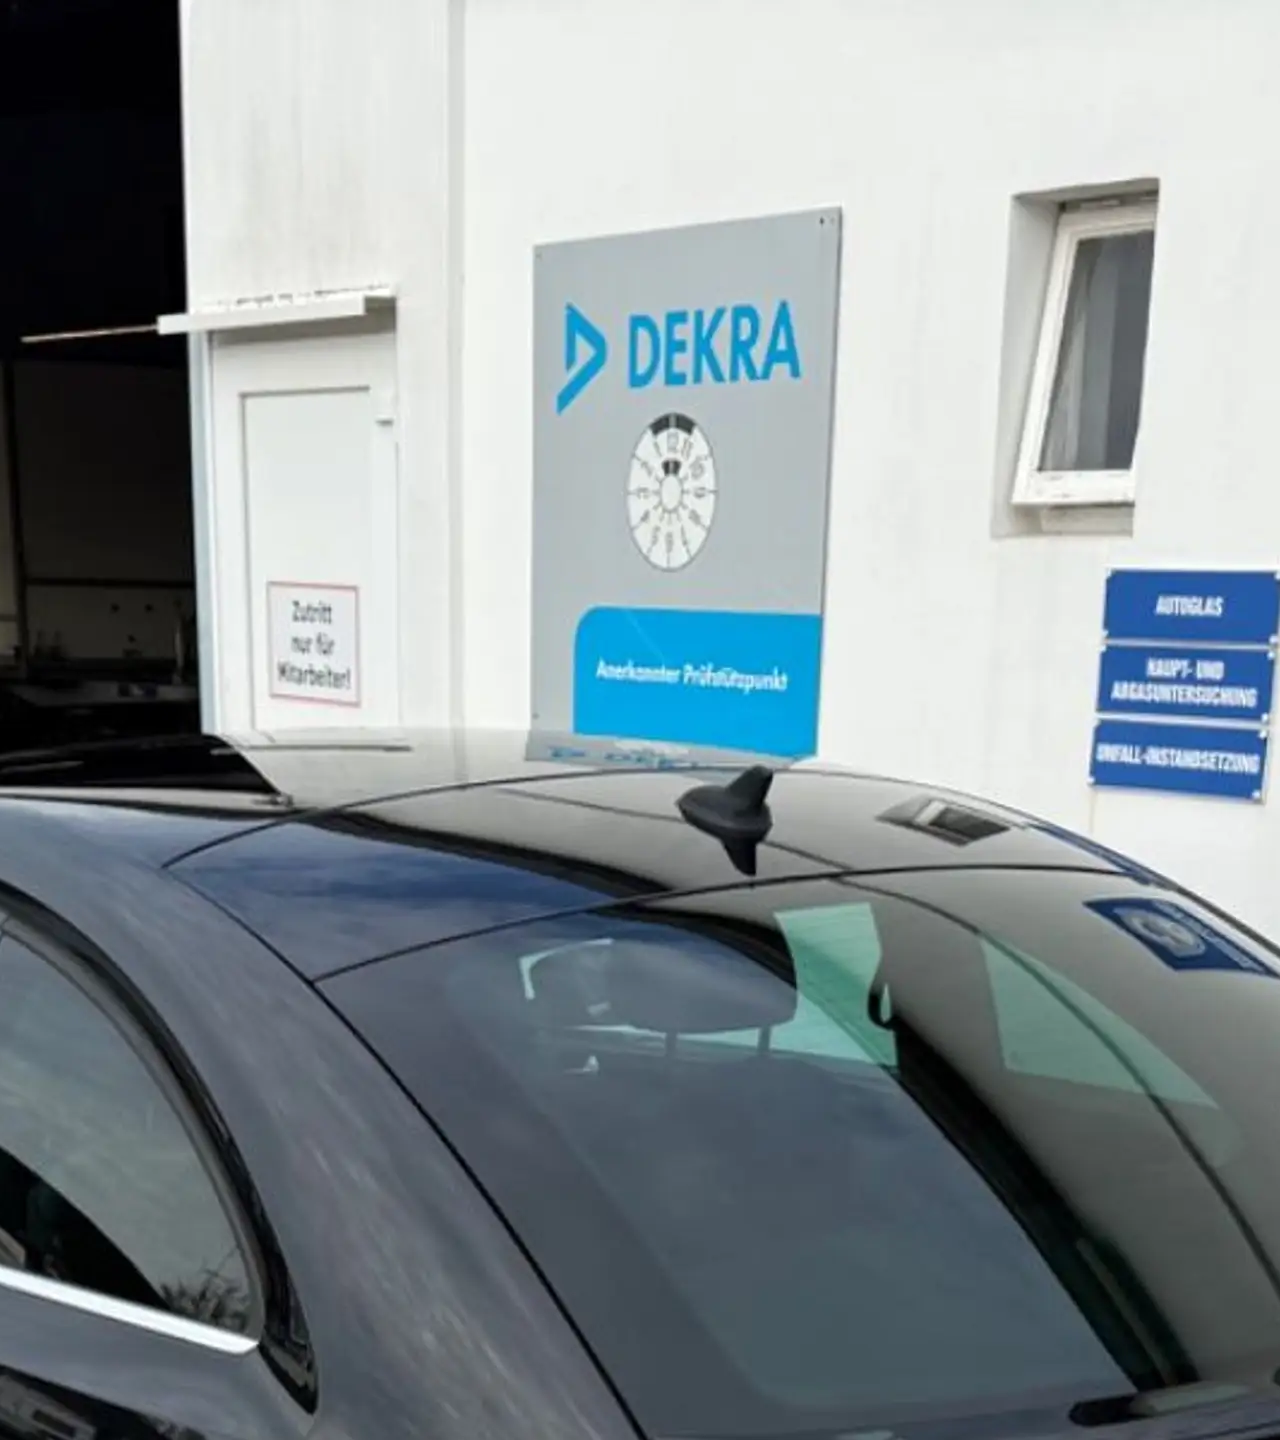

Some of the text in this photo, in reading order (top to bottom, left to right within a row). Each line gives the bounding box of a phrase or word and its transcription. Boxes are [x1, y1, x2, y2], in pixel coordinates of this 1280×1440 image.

[628, 300, 801, 389] DEKRA
[292, 599, 332, 625] Zutritt
[1153, 594, 1224, 618] AUTOGLAS
[291, 631, 335, 656] nur für
[277, 659, 351, 690] Mitarbeiter!
[595, 656, 682, 684] Anerkannter
[1196, 660, 1225, 681] UND
[1110, 680, 1259, 709] ABGASUNTERSUCHUNG
[1095, 742, 1261, 775] UNFALL-INSTANDSETZUNG
